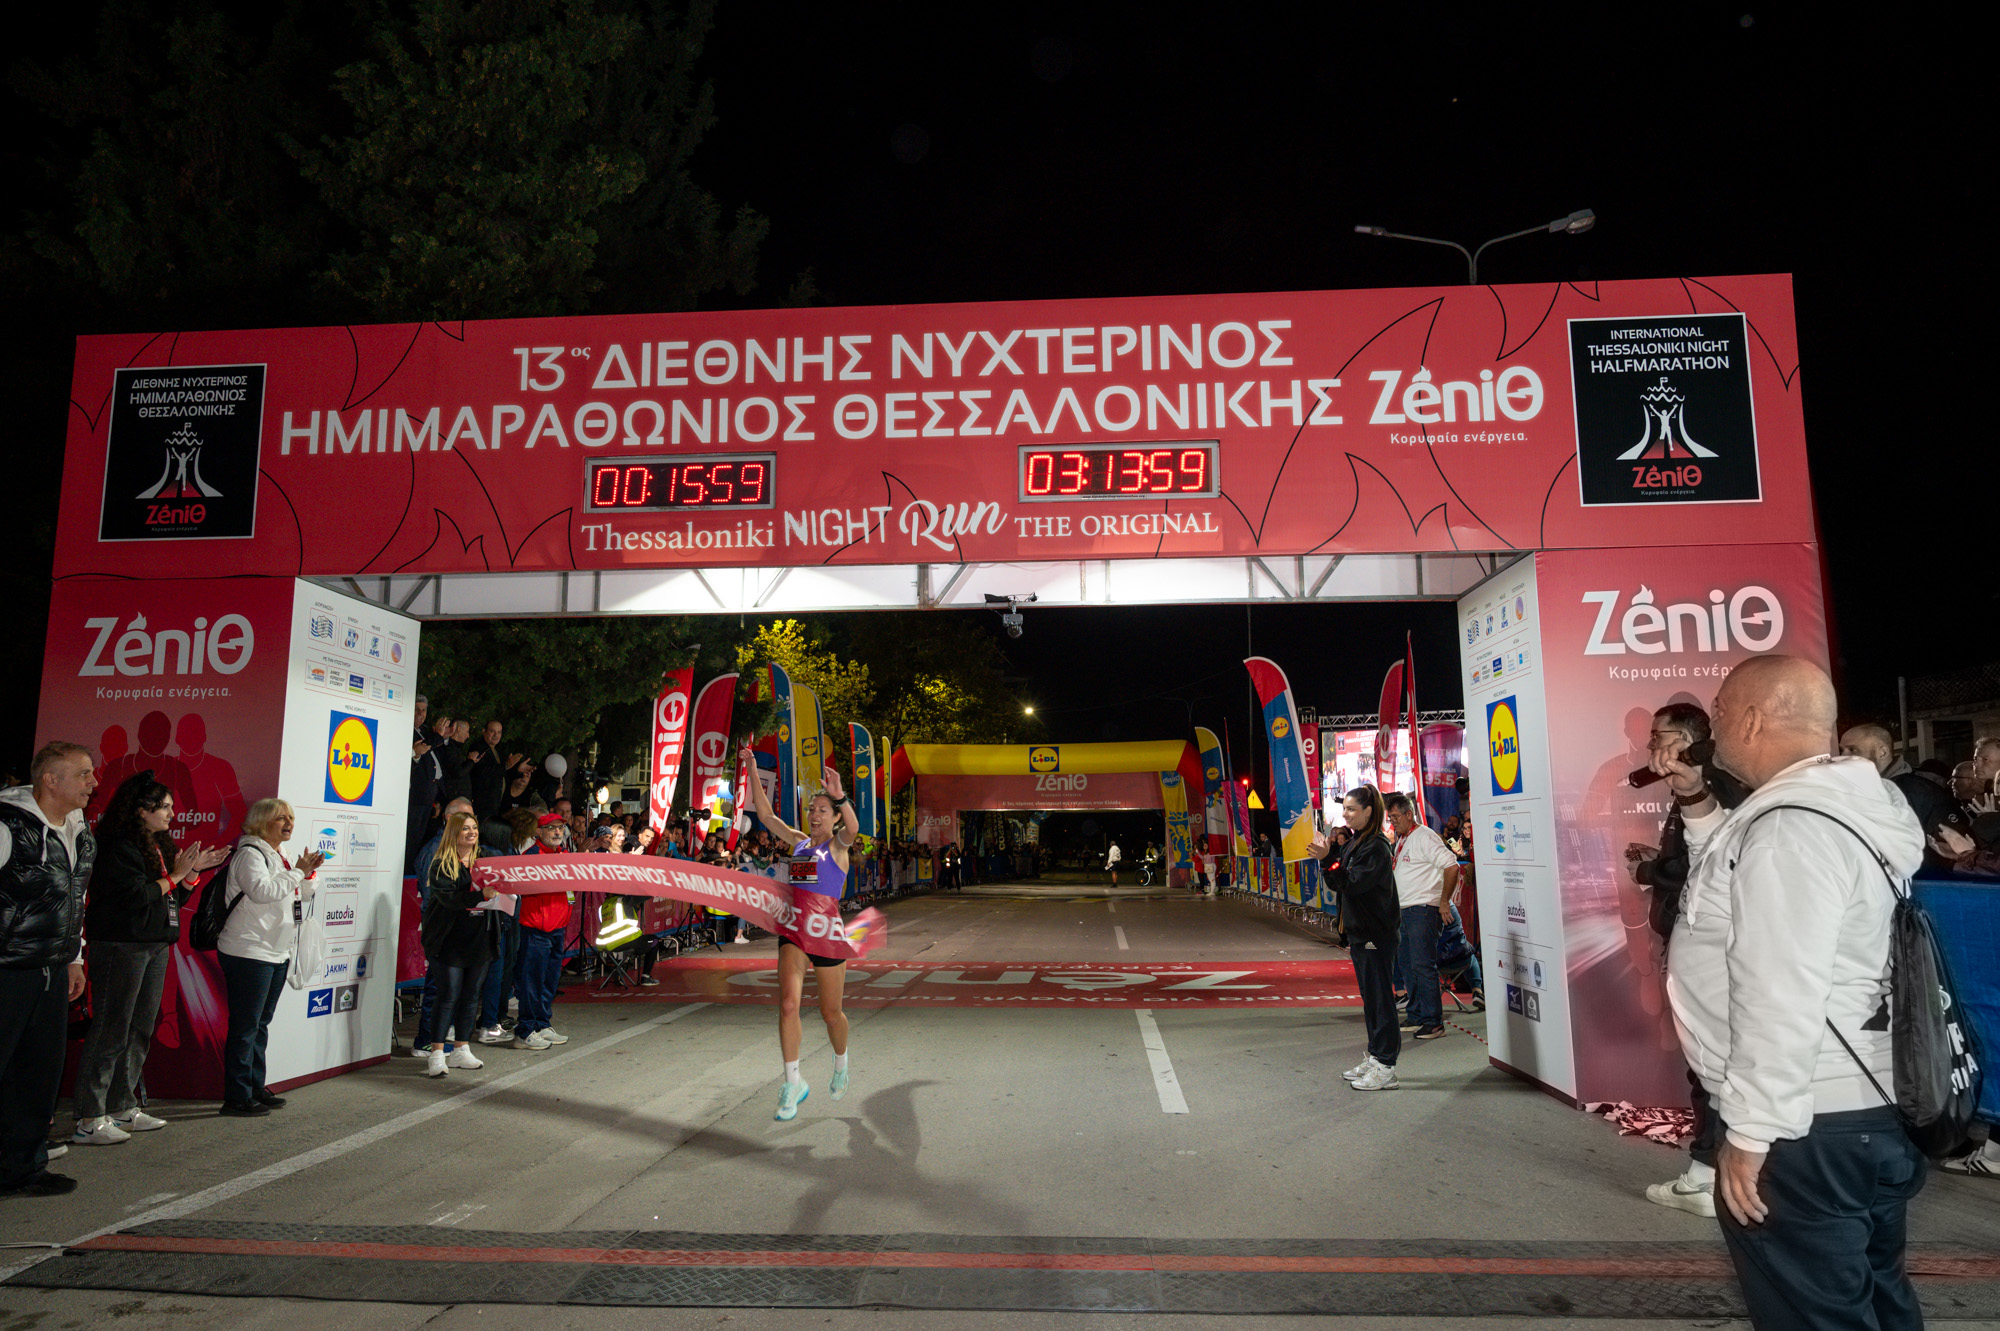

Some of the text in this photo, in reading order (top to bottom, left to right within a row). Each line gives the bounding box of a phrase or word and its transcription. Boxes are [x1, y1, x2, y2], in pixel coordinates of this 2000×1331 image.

[1610, 327, 1704, 340] INTERNATIONAL
[592, 335, 872, 389] ΔΙΕΘΝΗΣ
[892, 320, 1293, 379] ΝΥΧΤΕΡΙΝΟΣ
[1587, 340, 1730, 356] THESSALONIKI NIGHT
[1591, 355, 1730, 373] HALFMARATHON
[132, 376, 248, 389] ΔΙΕΘΝΗΣ ΝΥΧΤΕΡΙΝΟΣ
[130, 389, 247, 404] ΗΜΙΜΑΡΑΘΩΝΙΟΣ
[139, 404, 236, 418] ΘΕΣΣΑΛΟΝΙΚΗΣ
[281, 378, 1344, 456] ΗΜΙΜΑΡΑΘΩΝΙΟΣ ΘΕΣΣΑΛΟΝΙΚΗΣ
[1391, 431, 1528, 446] Κορυφαία ενέργεια.
[1028, 451, 1205, 494] 03:13:59
[595, 464, 764, 505] 00:15:59
[581, 499, 1219, 552] Thessaloniki NIGHT Run THE ORIGINAL
[1608, 665, 1687, 681] Κορυφαία
[96, 685, 232, 701] Κορυφαία ενέργεια.
[1425, 772, 1455, 786] 95.5
[177, 808, 216, 826] αέριο
[791, 862, 816, 873] 0366
[500, 864, 575, 883] ΔΙΕΘΝΗΣ
[570, 863, 672, 887] ΝΥΧΤΕΡΙΝΟΣ
[675, 871, 802, 932] ΗΜΙΜΑΡΑΘΩΝΙΟΣ
[326, 905, 354, 920] autodia
